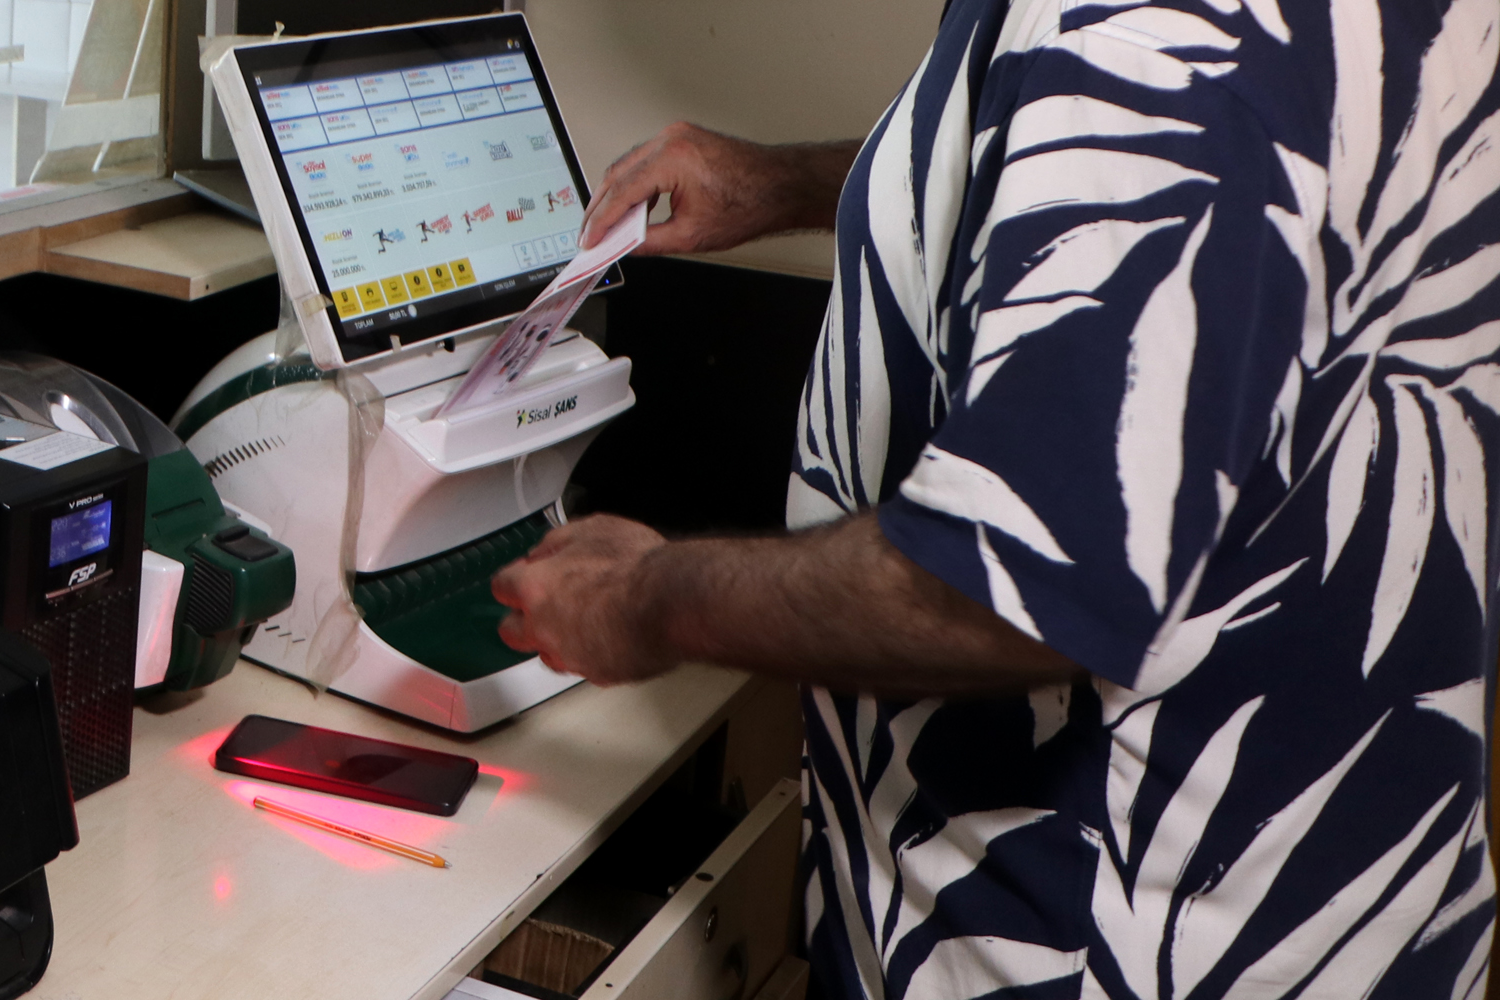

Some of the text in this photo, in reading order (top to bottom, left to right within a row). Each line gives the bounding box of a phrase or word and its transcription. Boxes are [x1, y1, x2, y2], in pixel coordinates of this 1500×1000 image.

[527, 404, 552, 425] Sisal
[76, 496, 93, 507] PRO
[68, 562, 97, 587] FSP
